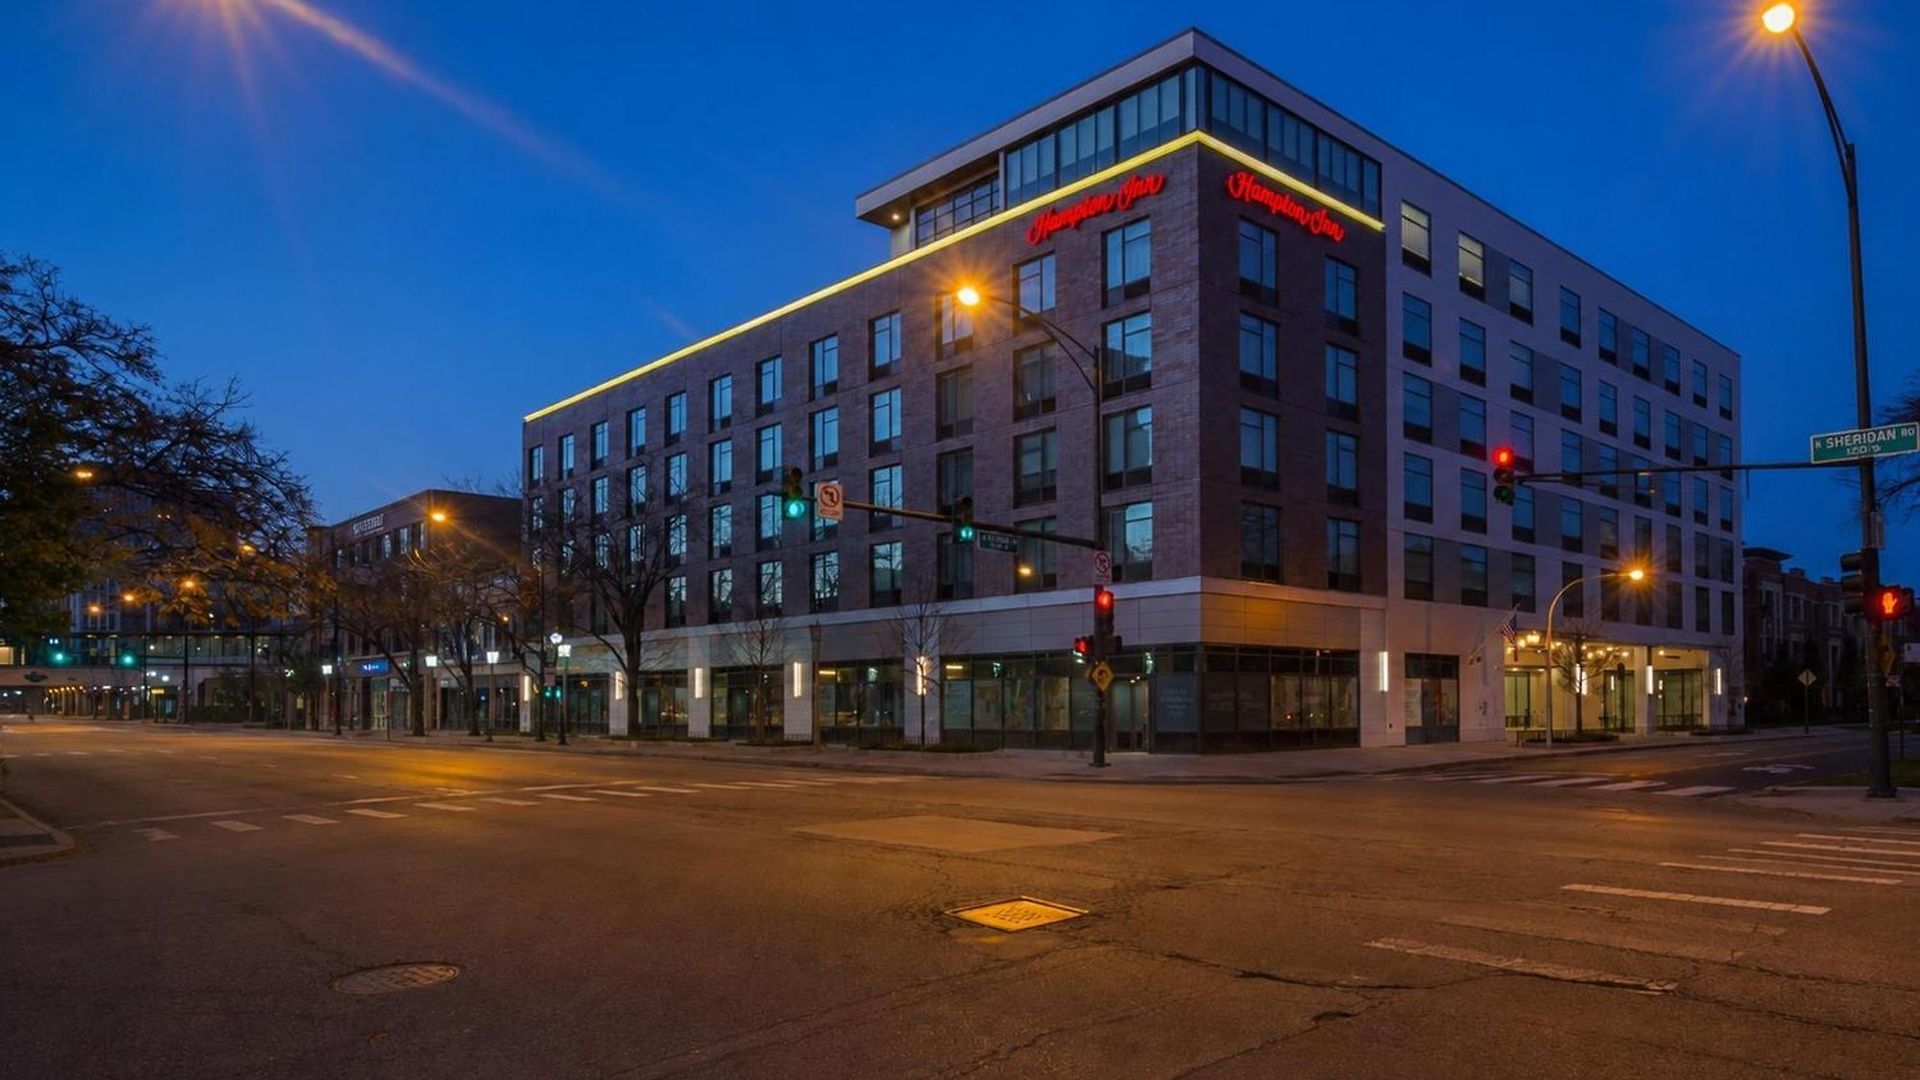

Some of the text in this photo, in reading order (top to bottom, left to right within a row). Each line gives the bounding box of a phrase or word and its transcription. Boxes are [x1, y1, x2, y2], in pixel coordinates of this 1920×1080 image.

[1026, 172, 1166, 245] Hampton Inn
[1225, 171, 1344, 243] Hampton Inn
[1826, 429, 1897, 449] SHERIDAN
